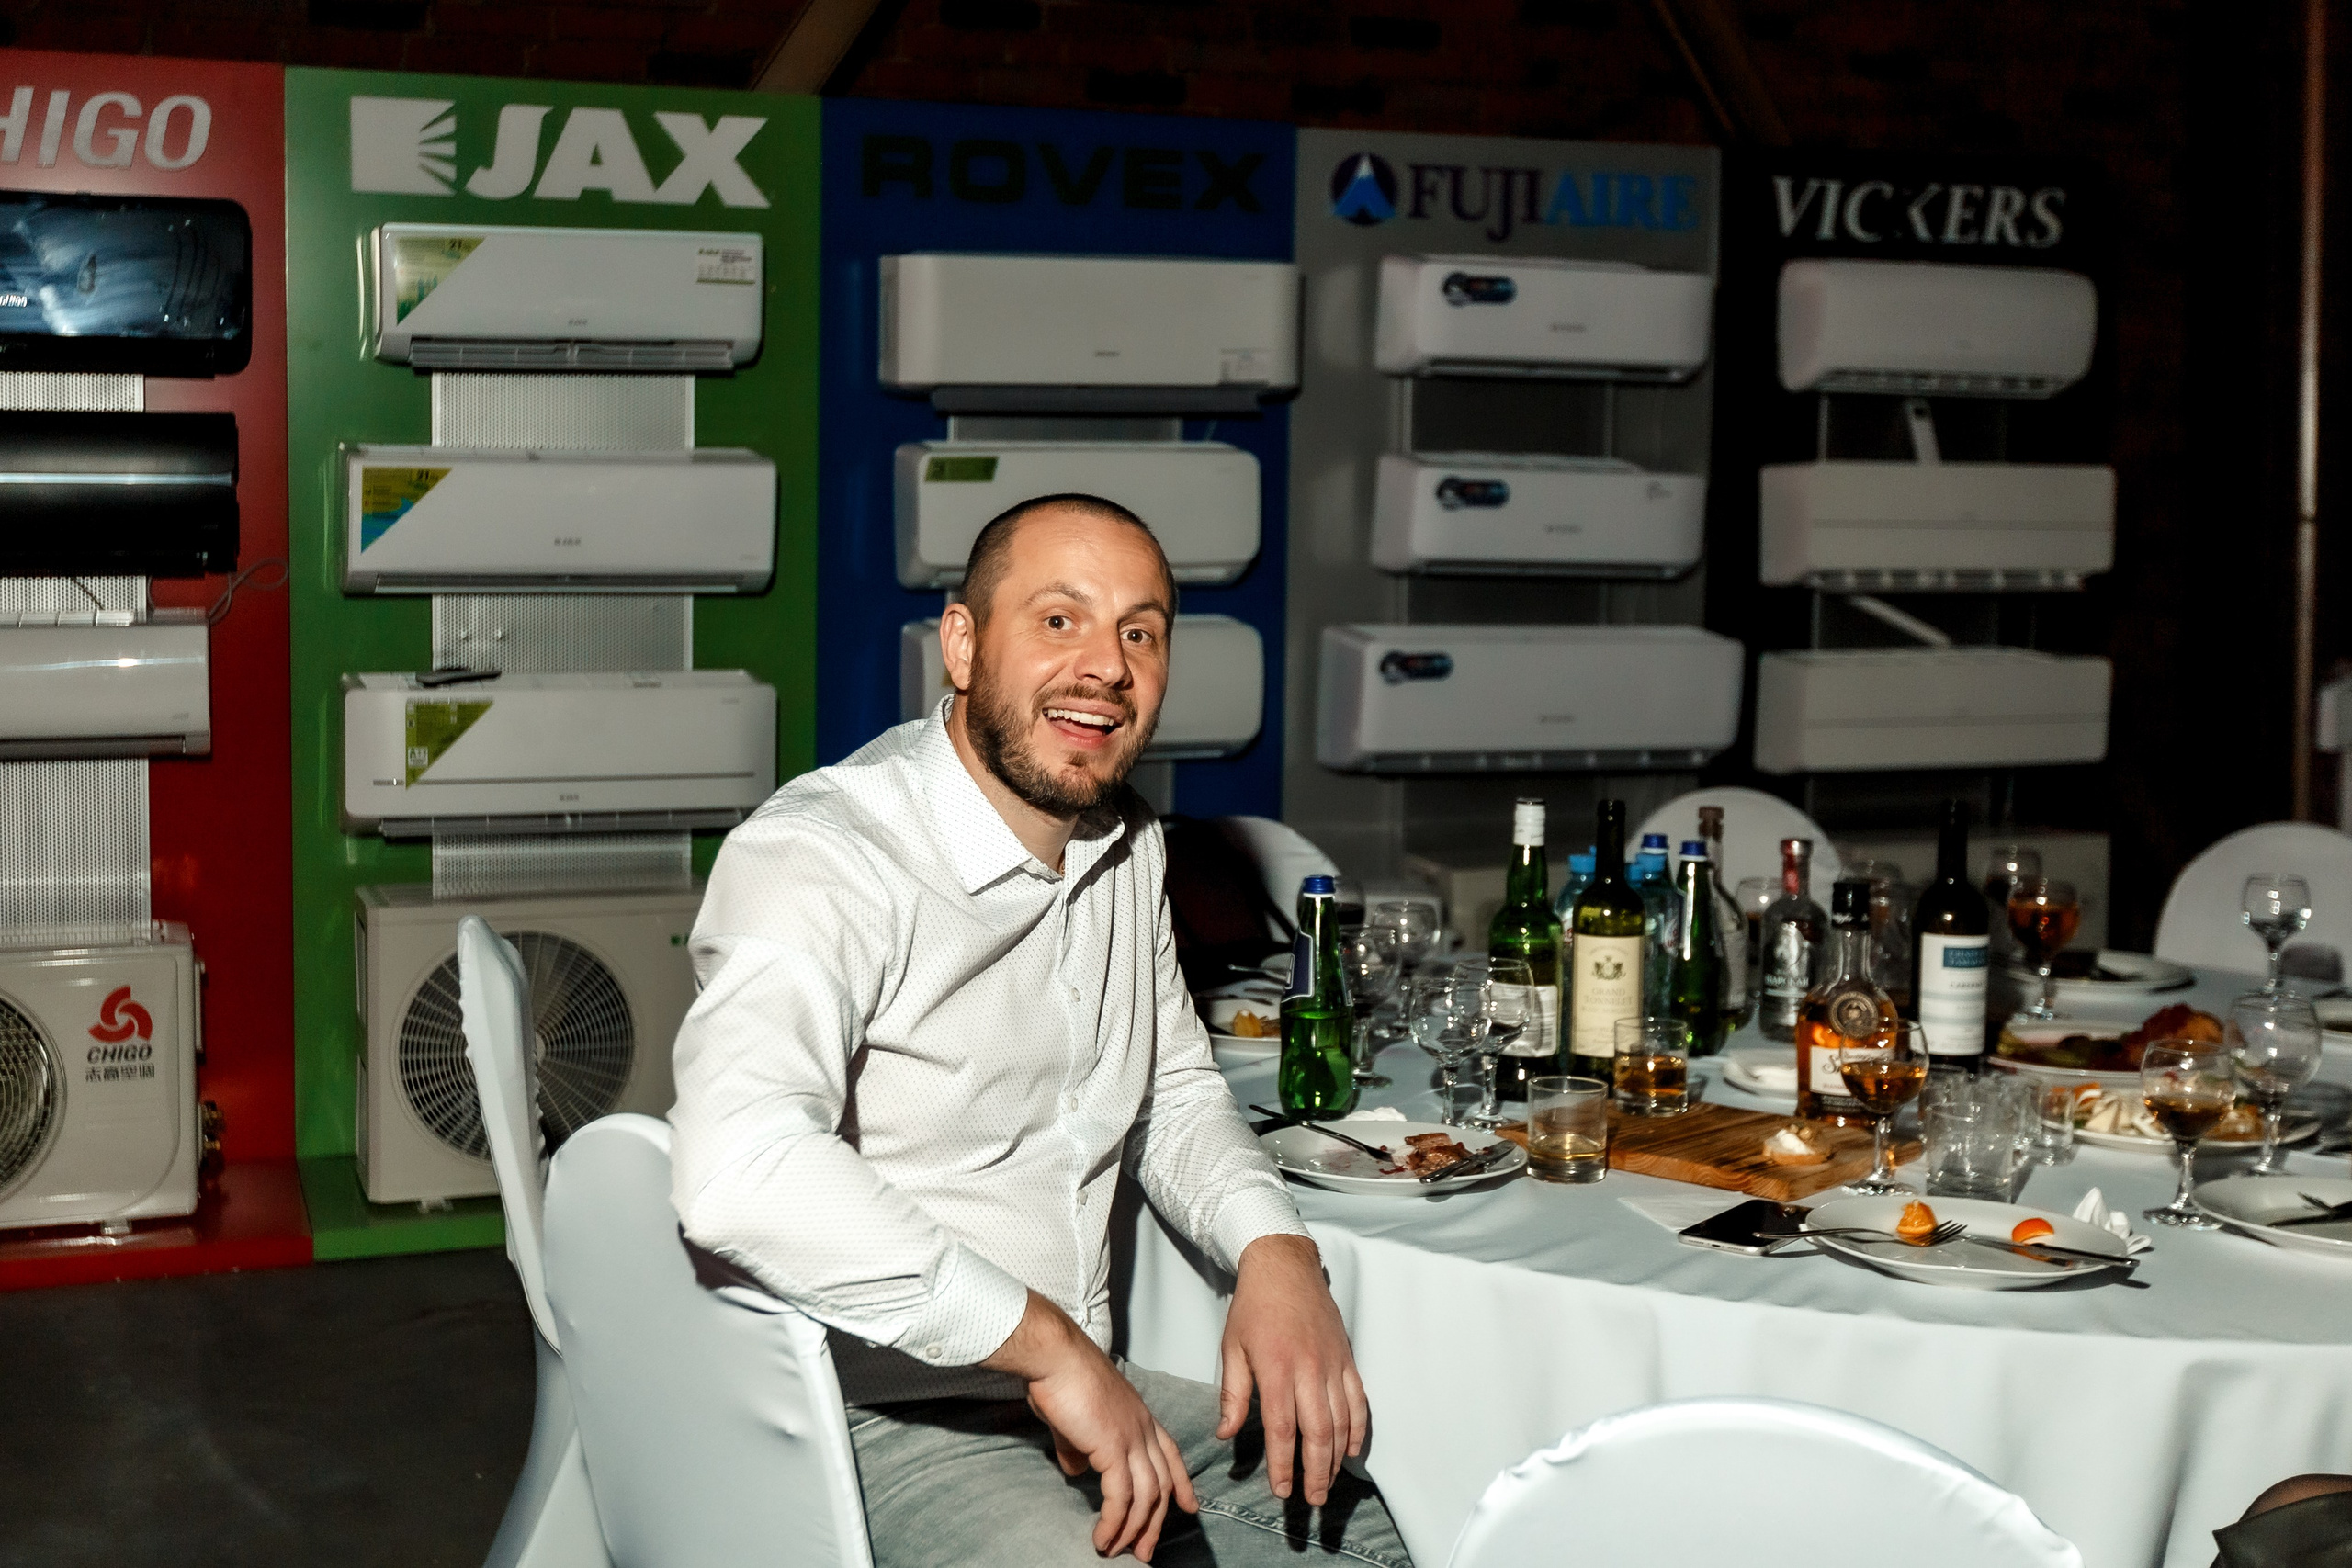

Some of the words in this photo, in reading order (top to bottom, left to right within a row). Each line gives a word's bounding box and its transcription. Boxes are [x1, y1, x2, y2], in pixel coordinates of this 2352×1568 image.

[465, 103, 772, 209] JAX
[862, 134, 1264, 212] ROVEX
[1407, 162, 1698, 242] FUJIAIRE
[1771, 174, 2067, 249] VICKERS
[86, 1043, 153, 1065] CHIGO
